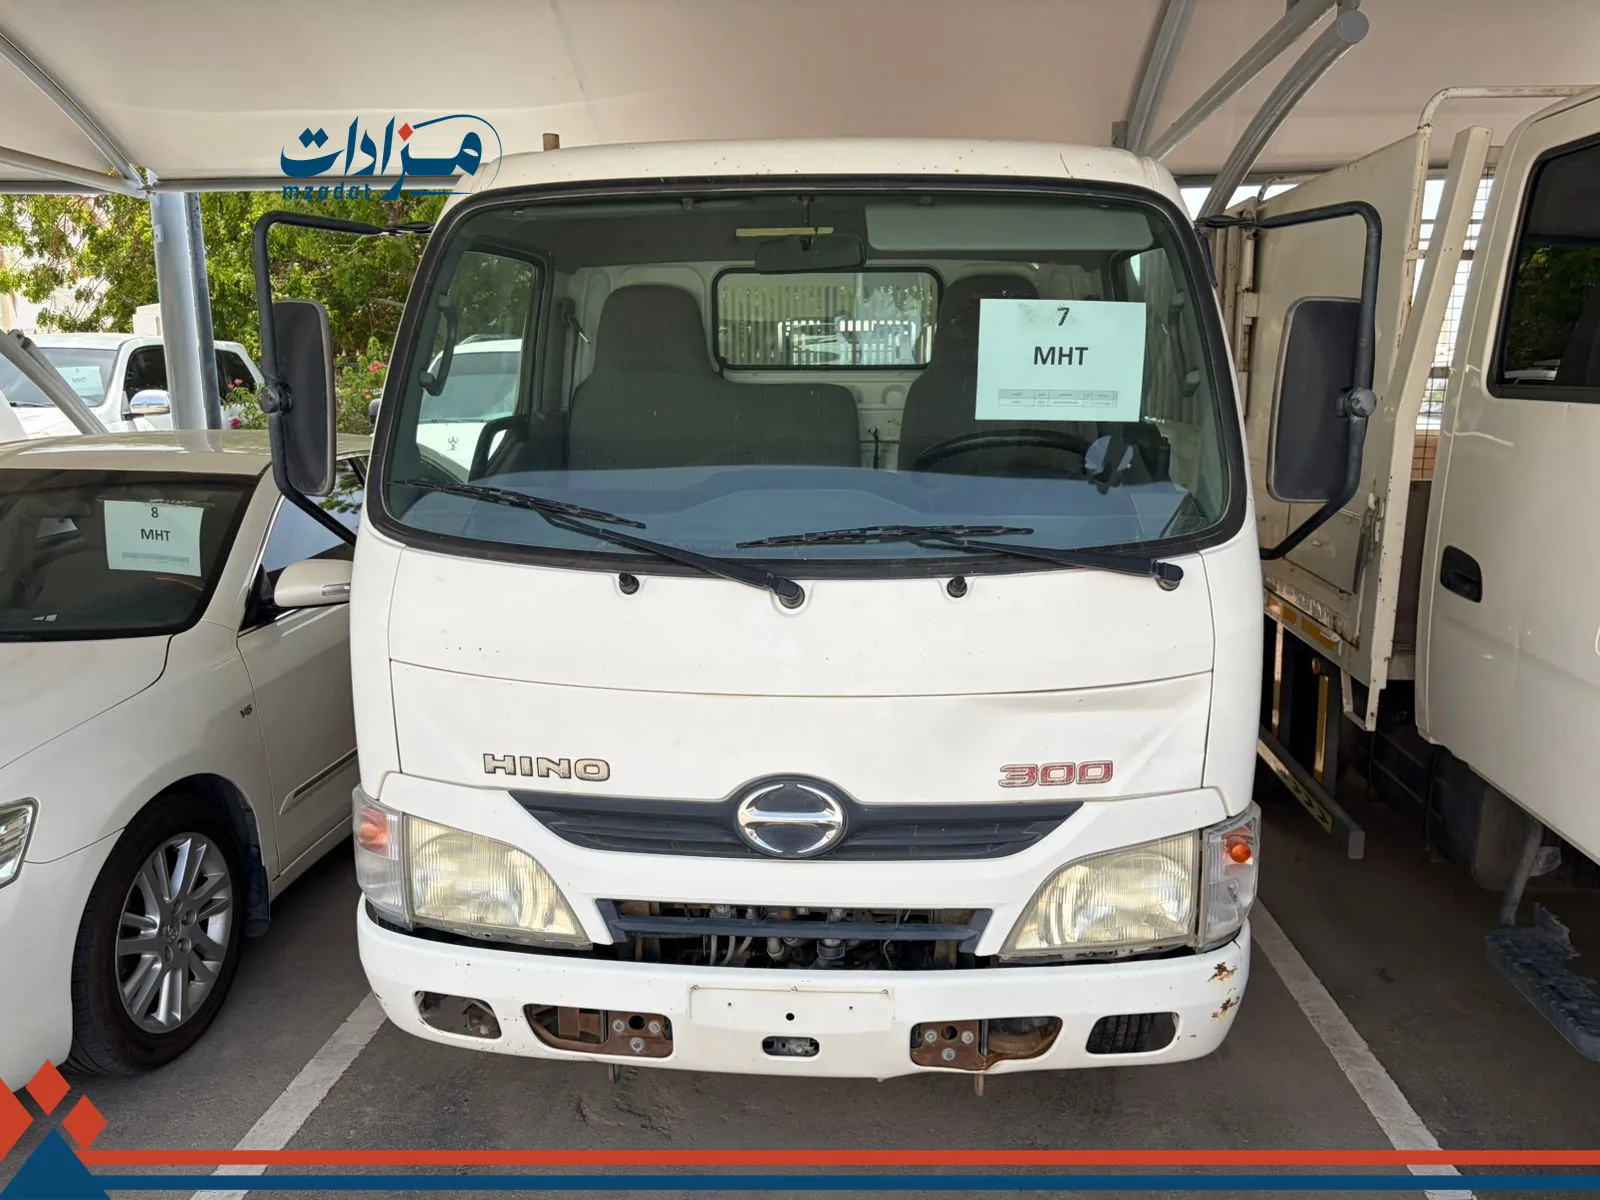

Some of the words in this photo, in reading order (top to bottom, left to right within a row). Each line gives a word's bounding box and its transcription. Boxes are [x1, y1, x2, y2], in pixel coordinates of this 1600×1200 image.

[1057, 307, 1070, 326] 7
[1034, 346, 1089, 365] MHT
[151, 507, 159, 518] 8
[140, 528, 171, 541] MHT
[240, 704, 253, 719] V6
[483, 753, 610, 782] HINO
[998, 760, 1113, 788] 300
